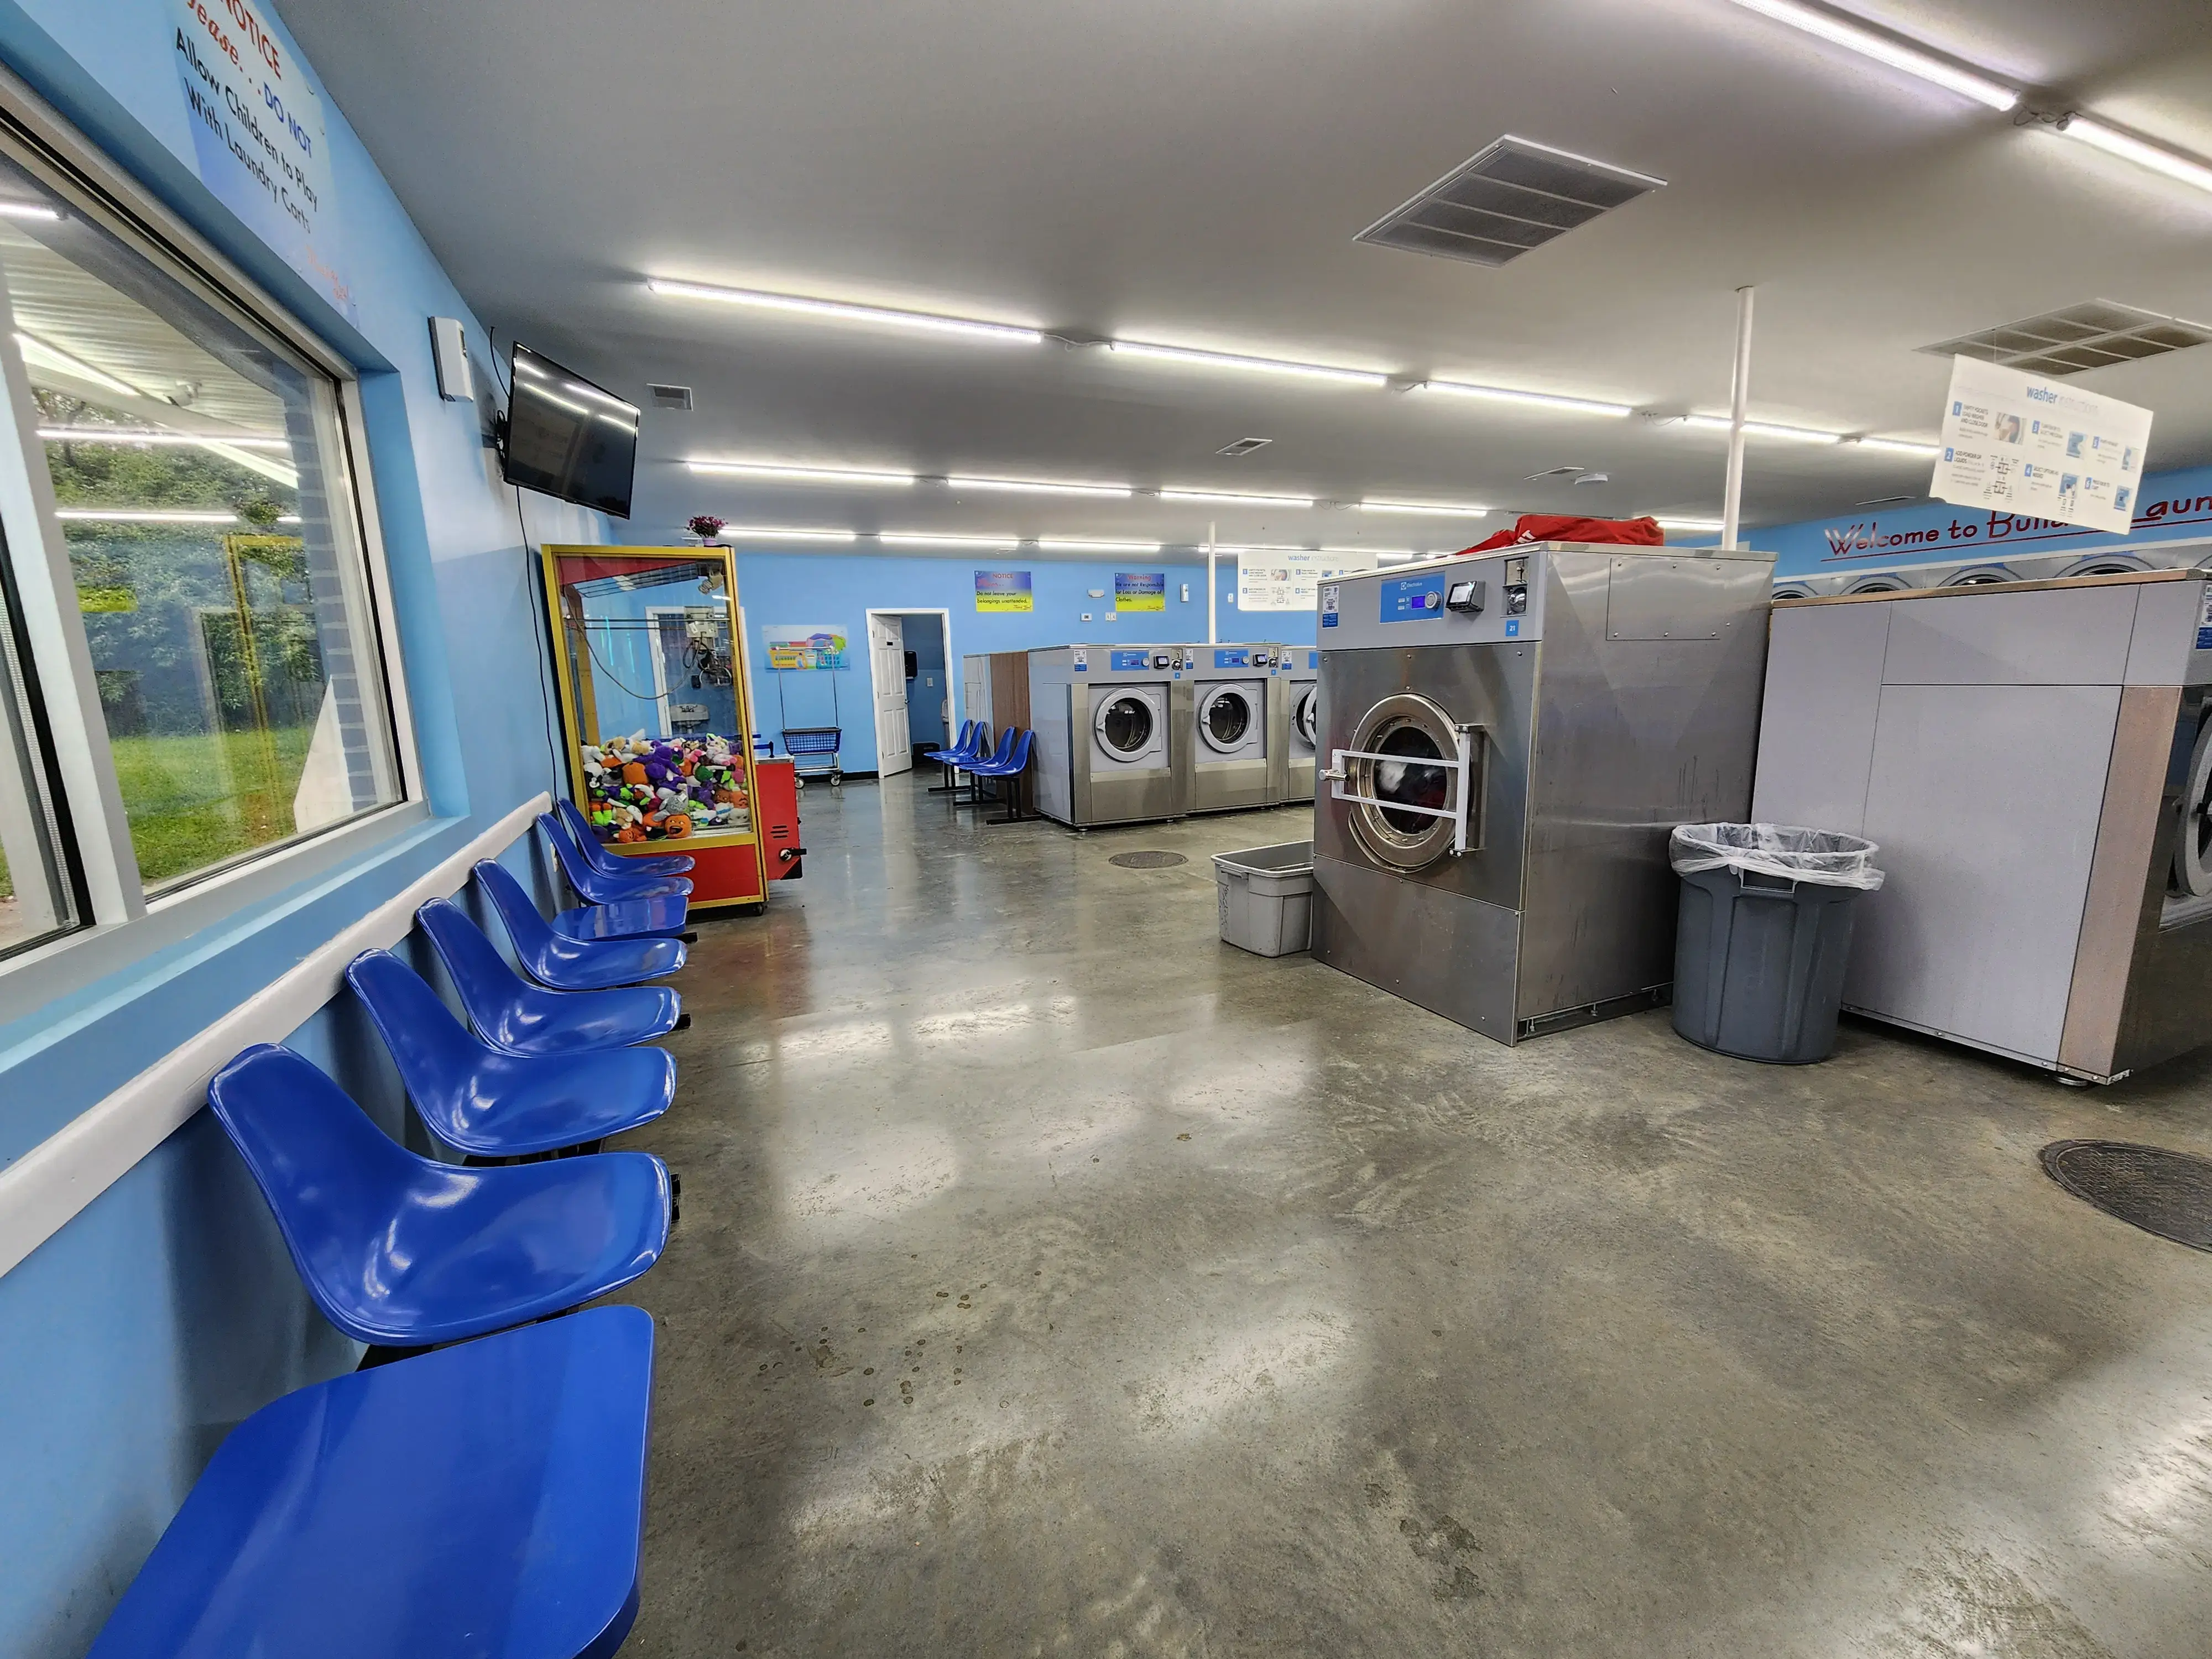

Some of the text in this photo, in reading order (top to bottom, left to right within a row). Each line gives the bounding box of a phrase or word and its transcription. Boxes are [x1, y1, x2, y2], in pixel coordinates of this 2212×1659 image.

[176, 26, 317, 212] Allow Children to Play
[184, 77, 310, 234] With Laundry Carts
[264, 81, 284, 123] DO
[287, 111, 311, 158] NOT
[2027, 386, 2058, 405] washer
[1824, 521, 1939, 556] Welcome
[1947, 520, 1978, 539] to
